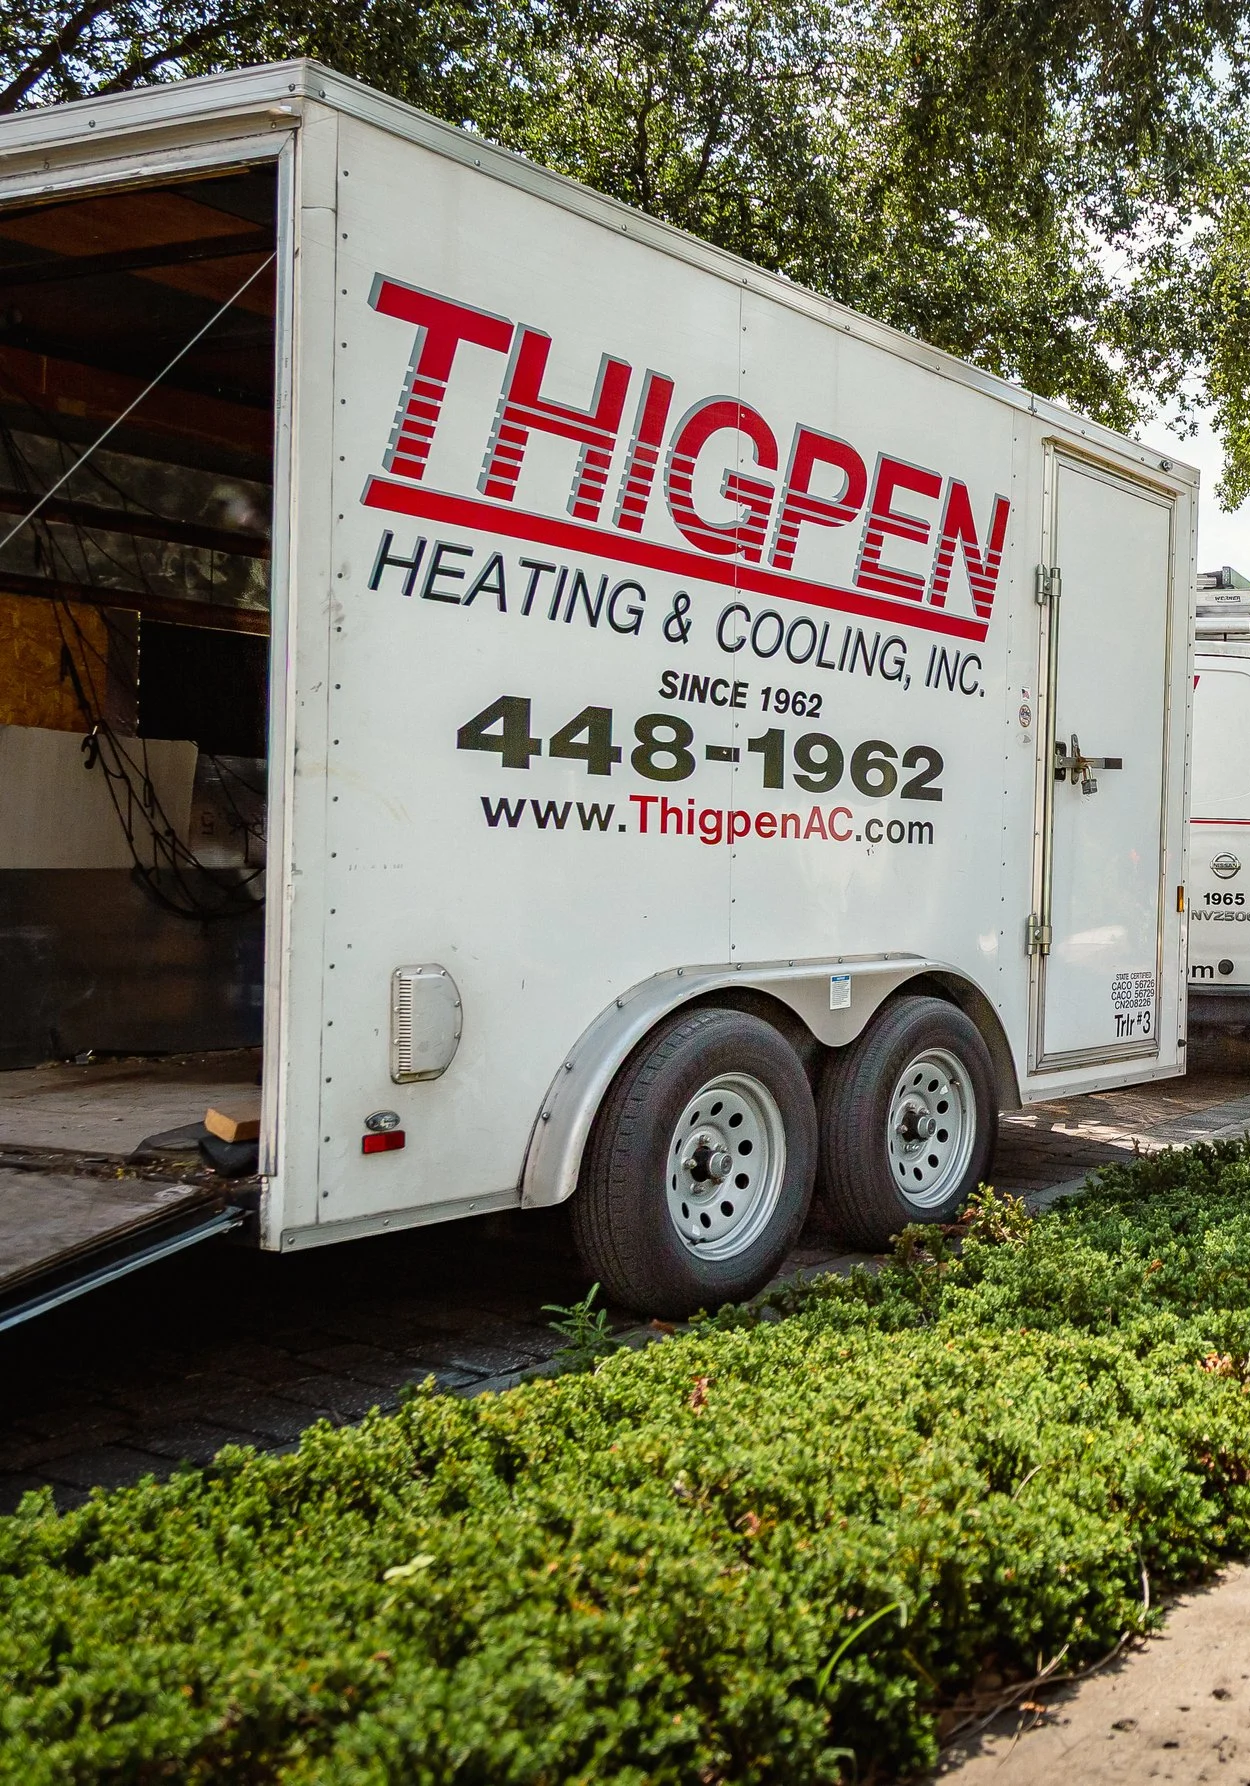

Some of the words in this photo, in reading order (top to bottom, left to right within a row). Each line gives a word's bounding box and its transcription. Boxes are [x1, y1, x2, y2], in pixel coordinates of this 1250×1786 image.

[367, 272, 1010, 620] THIGPEN
[367, 529, 647, 636] HEATING
[662, 590, 693, 645] &
[716, 602, 912, 688] COOLING,
[926, 645, 987, 698] INC.
[658, 670, 748, 709] SINCE
[760, 687, 823, 719] 1962
[456, 694, 945, 802] 448-1962
[480, 794, 935, 846] www.ThigpenAC.com
[1203, 892, 1245, 906] 1965
[1116, 973, 1129, 981] STATE
[1130, 972, 1152, 980] CERTIFIED
[1114, 1013, 1135, 1037] Trlr
